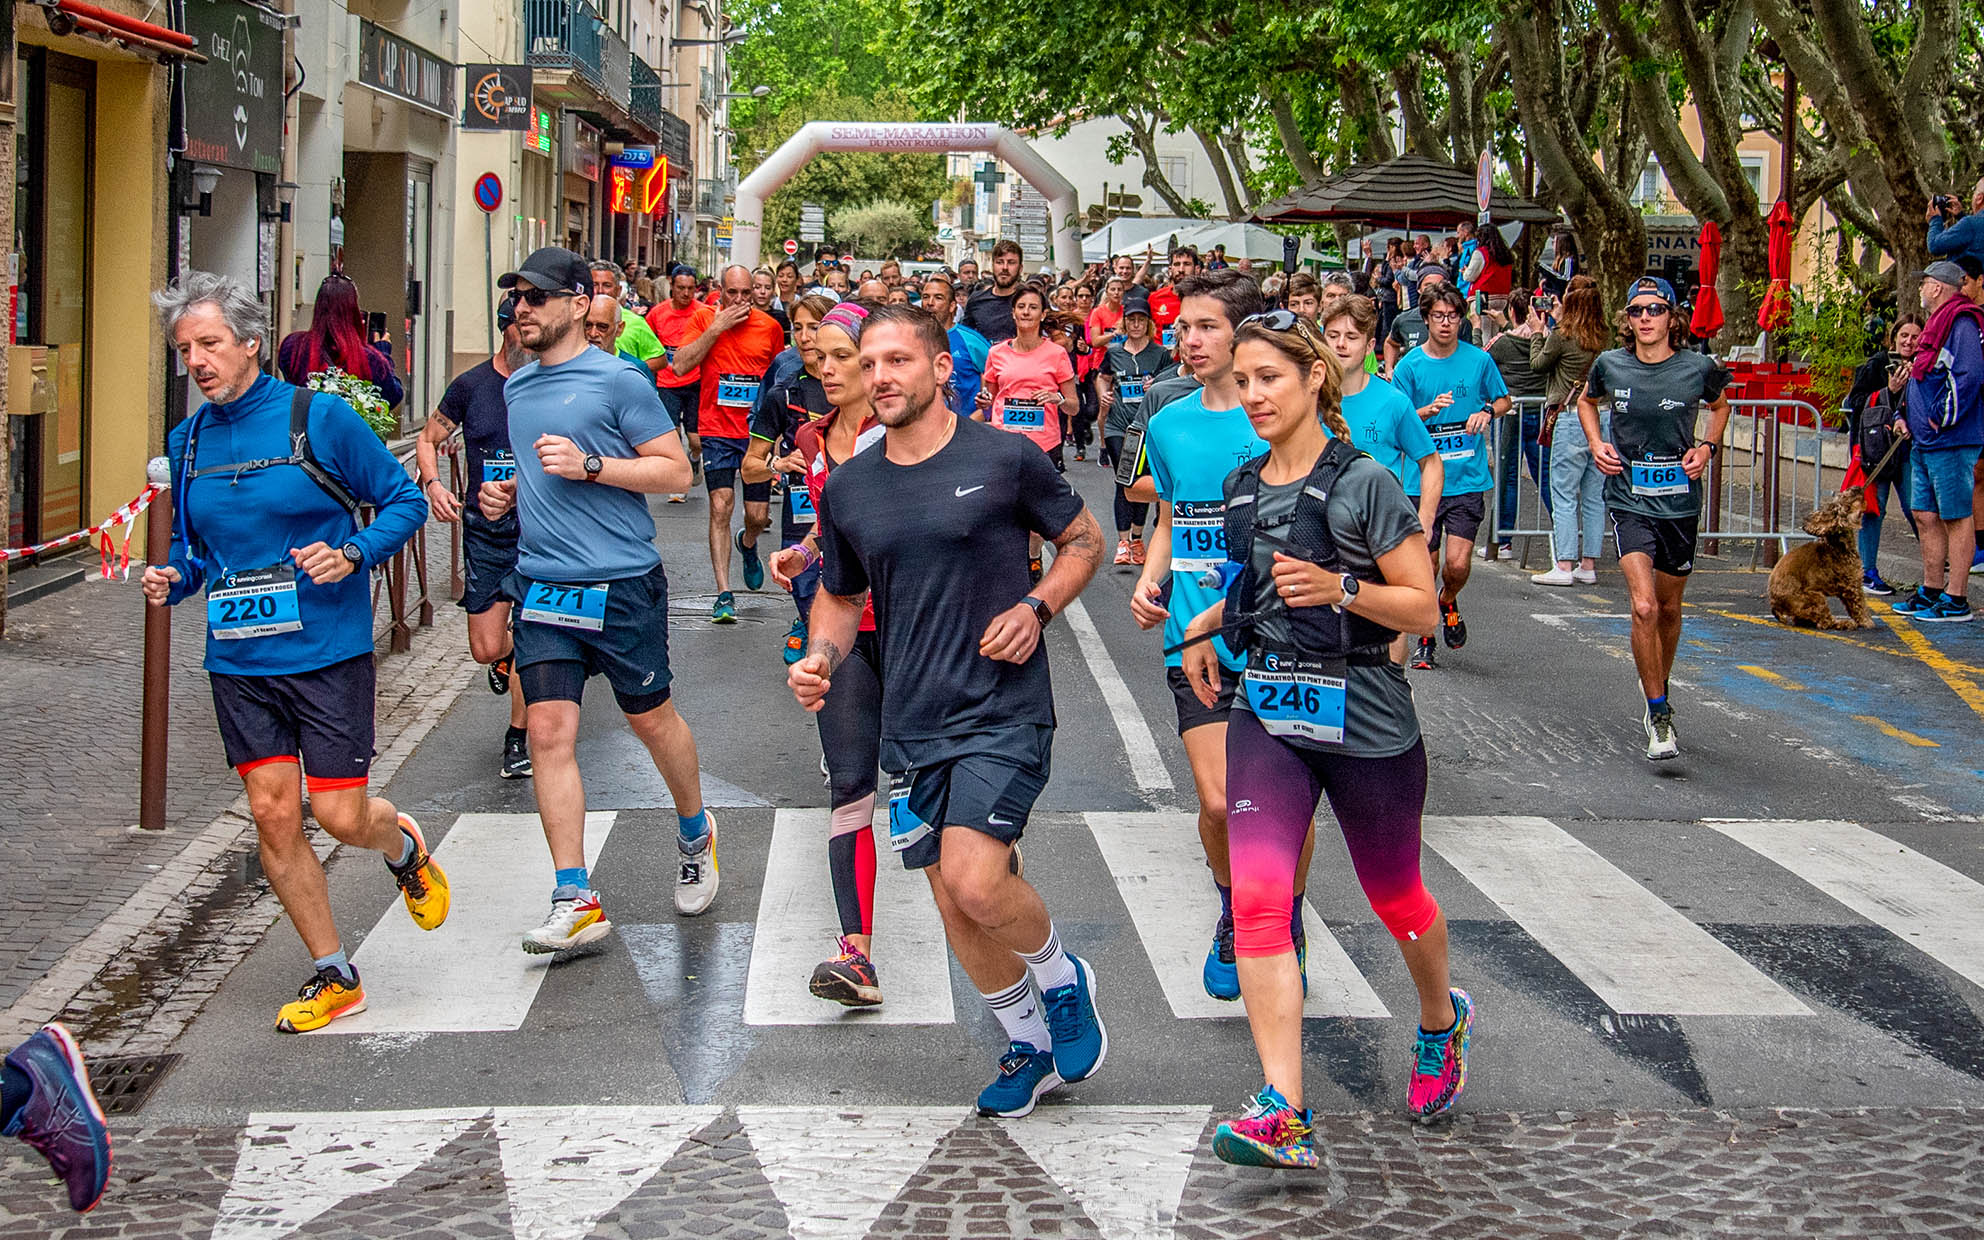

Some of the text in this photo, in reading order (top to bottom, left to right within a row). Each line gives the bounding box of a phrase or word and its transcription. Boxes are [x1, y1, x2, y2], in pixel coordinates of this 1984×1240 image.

[212, 32, 231, 62] CHEZ
[378, 36, 398, 89] CAP
[400, 47, 418, 97] SUD
[419, 56, 441, 106] IMMO
[504, 106, 527, 114] IMMO
[831, 127, 987, 140] SEMI-MARATHON
[869, 139, 950, 148] DU PONT ROUGE
[724, 386, 750, 399] 221
[1008, 410, 1036, 423] 229
[1434, 436, 1464, 450] 213
[1640, 468, 1676, 483] 166
[1182, 529, 1227, 552] 198
[223, 589, 250, 598] MARATHON
[536, 586, 585, 610] 271
[220, 596, 277, 623] 220
[1322, 680, 1343, 688] ROUGE
[1258, 684, 1321, 715] 246
